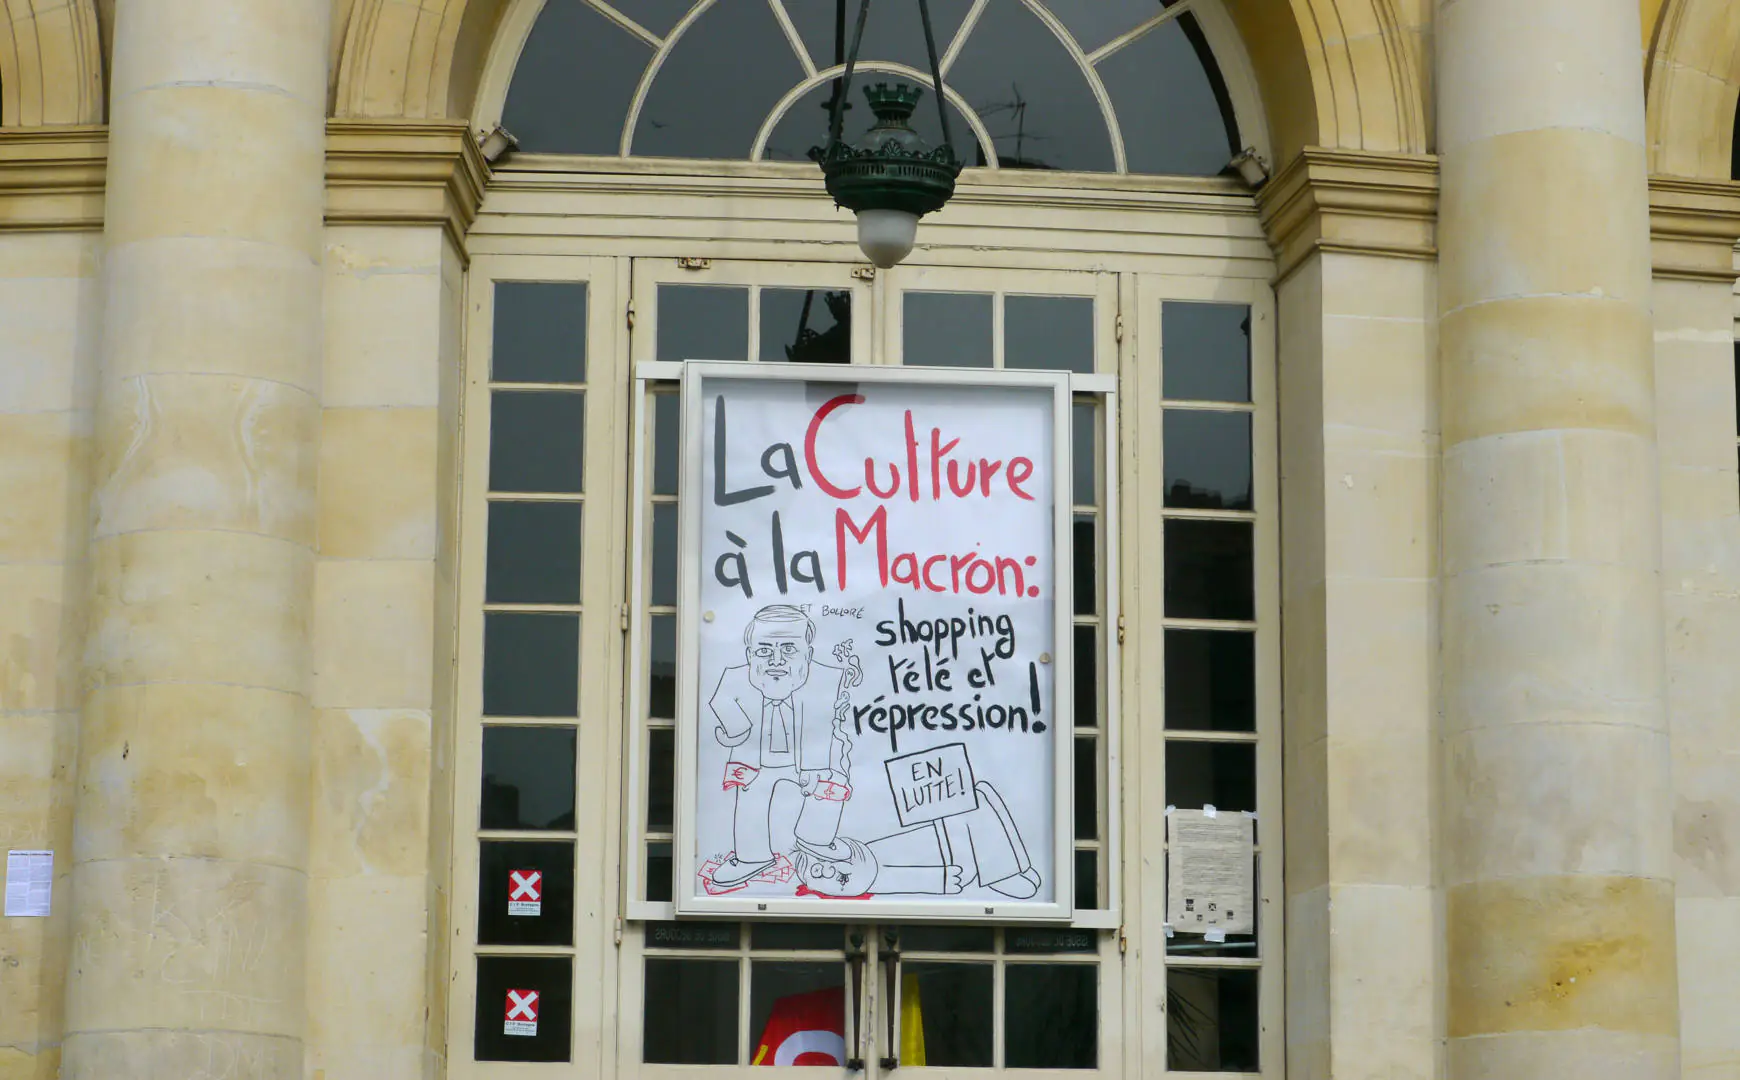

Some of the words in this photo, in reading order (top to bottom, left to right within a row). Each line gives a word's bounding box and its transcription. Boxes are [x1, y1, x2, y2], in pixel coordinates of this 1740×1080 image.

[714, 394, 802, 506] La
[804, 393, 1035, 502] Culture
[715, 530, 753, 599] à
[771, 510, 825, 595] la
[836, 504, 1040, 599] Macron:
[874, 598, 1016, 660] shopping
[888, 645, 953, 694] télé
[967, 646, 996, 689] et
[901, 767, 967, 813] LUTTE!
[911, 757, 943, 782] EN
